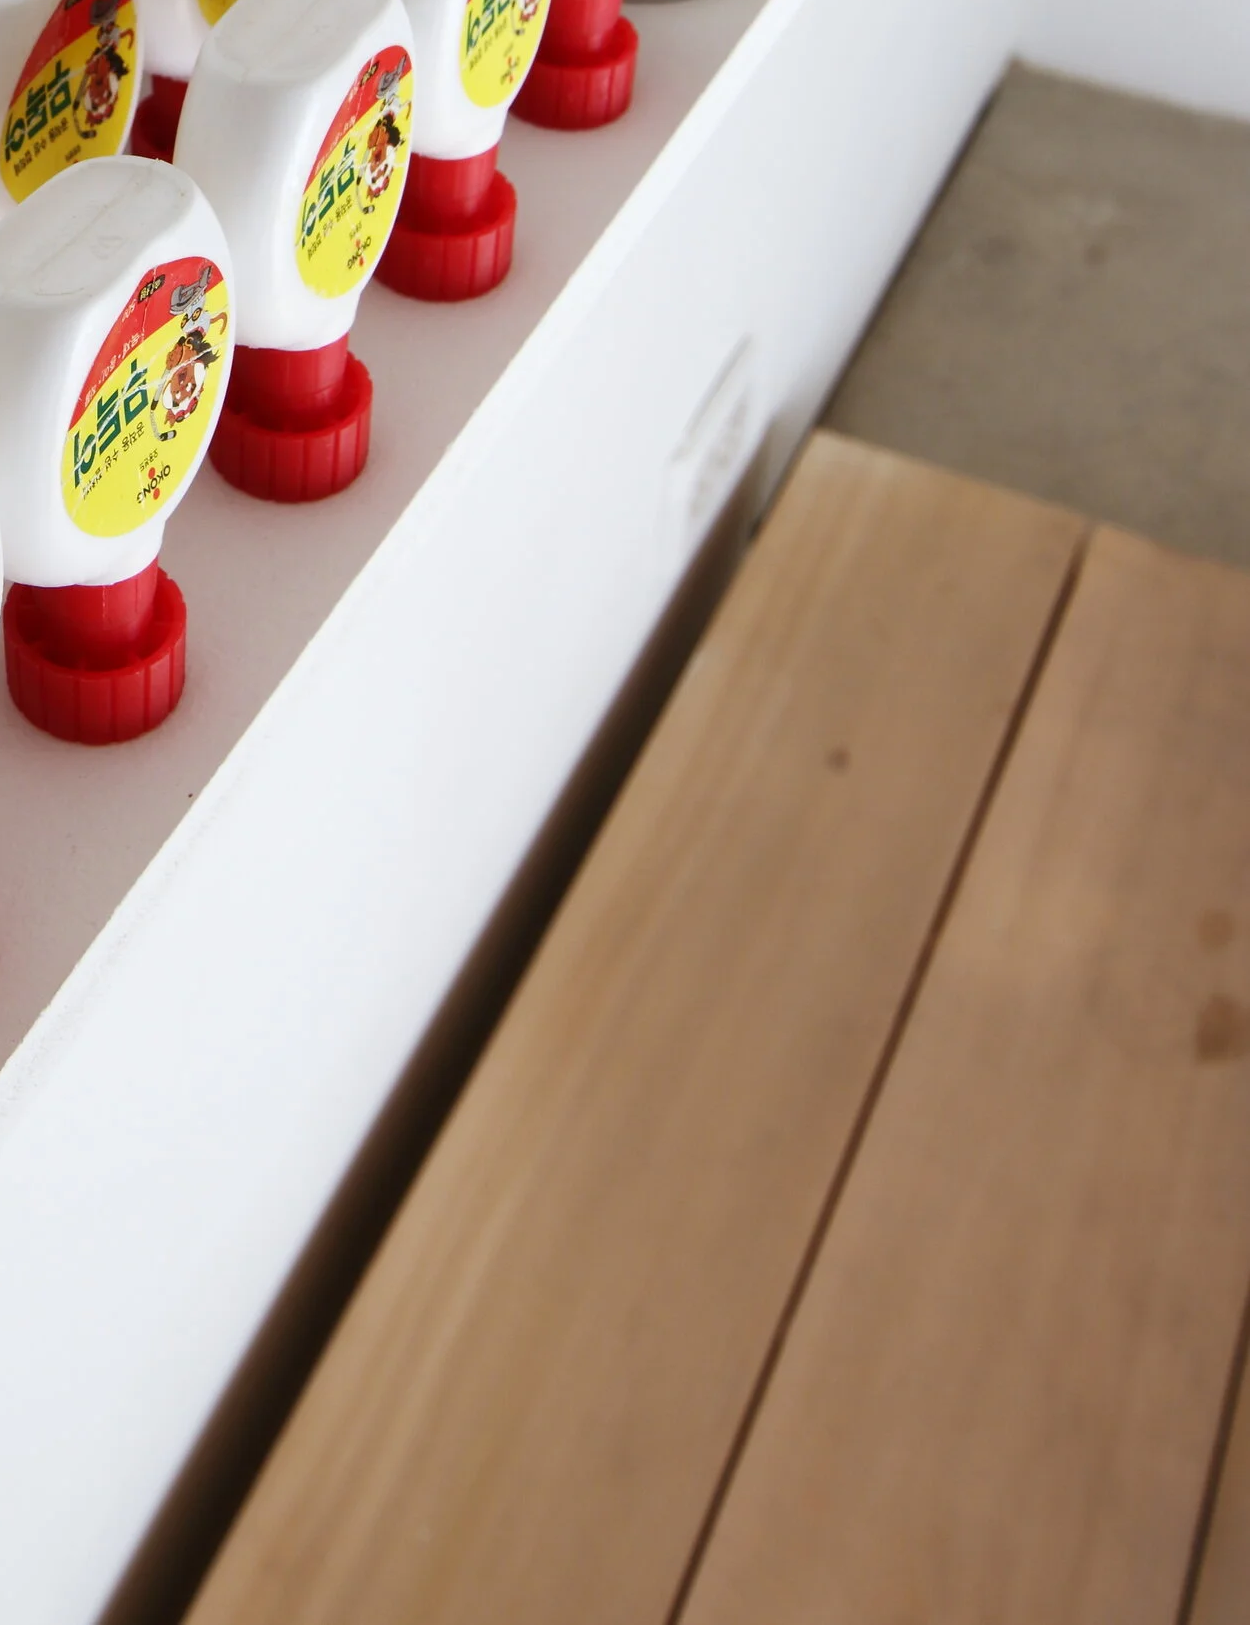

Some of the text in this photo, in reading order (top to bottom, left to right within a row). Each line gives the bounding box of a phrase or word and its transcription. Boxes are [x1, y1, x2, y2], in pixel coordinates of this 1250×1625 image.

[7, 60, 74, 154] 무독이
[72, 359, 150, 488] 무독이
[136, 465, 171, 504] OKONG
